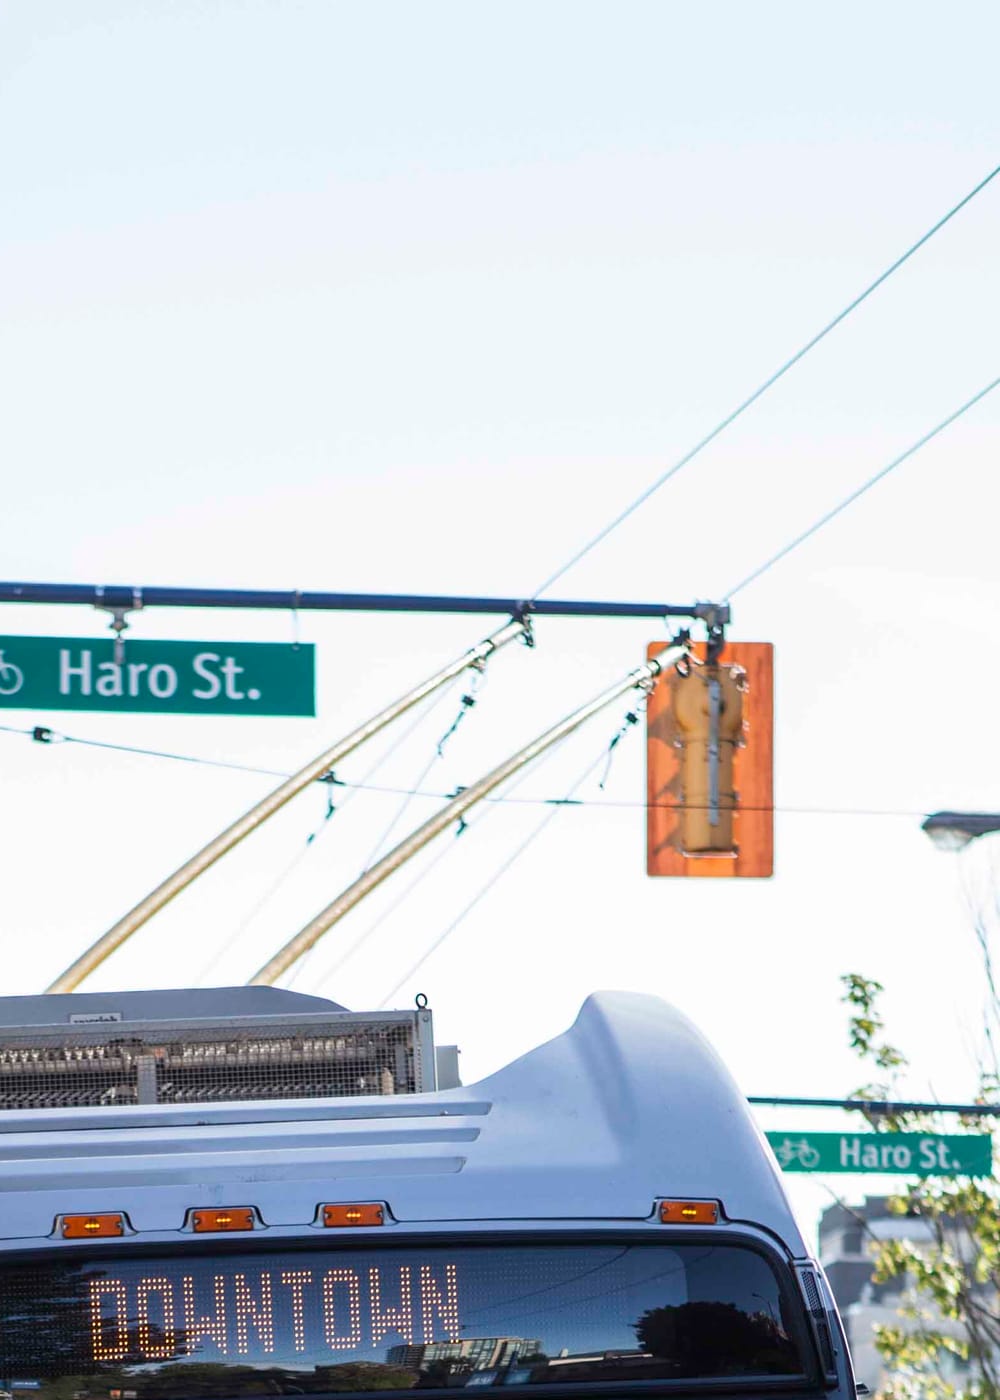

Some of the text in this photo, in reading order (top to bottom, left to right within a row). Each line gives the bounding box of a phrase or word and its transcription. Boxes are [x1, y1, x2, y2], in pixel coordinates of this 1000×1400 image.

[59, 649, 262, 700] Haro St.
[839, 1136, 962, 1170] Haro St.
[90, 1265, 461, 1361] DOWNTOWN
